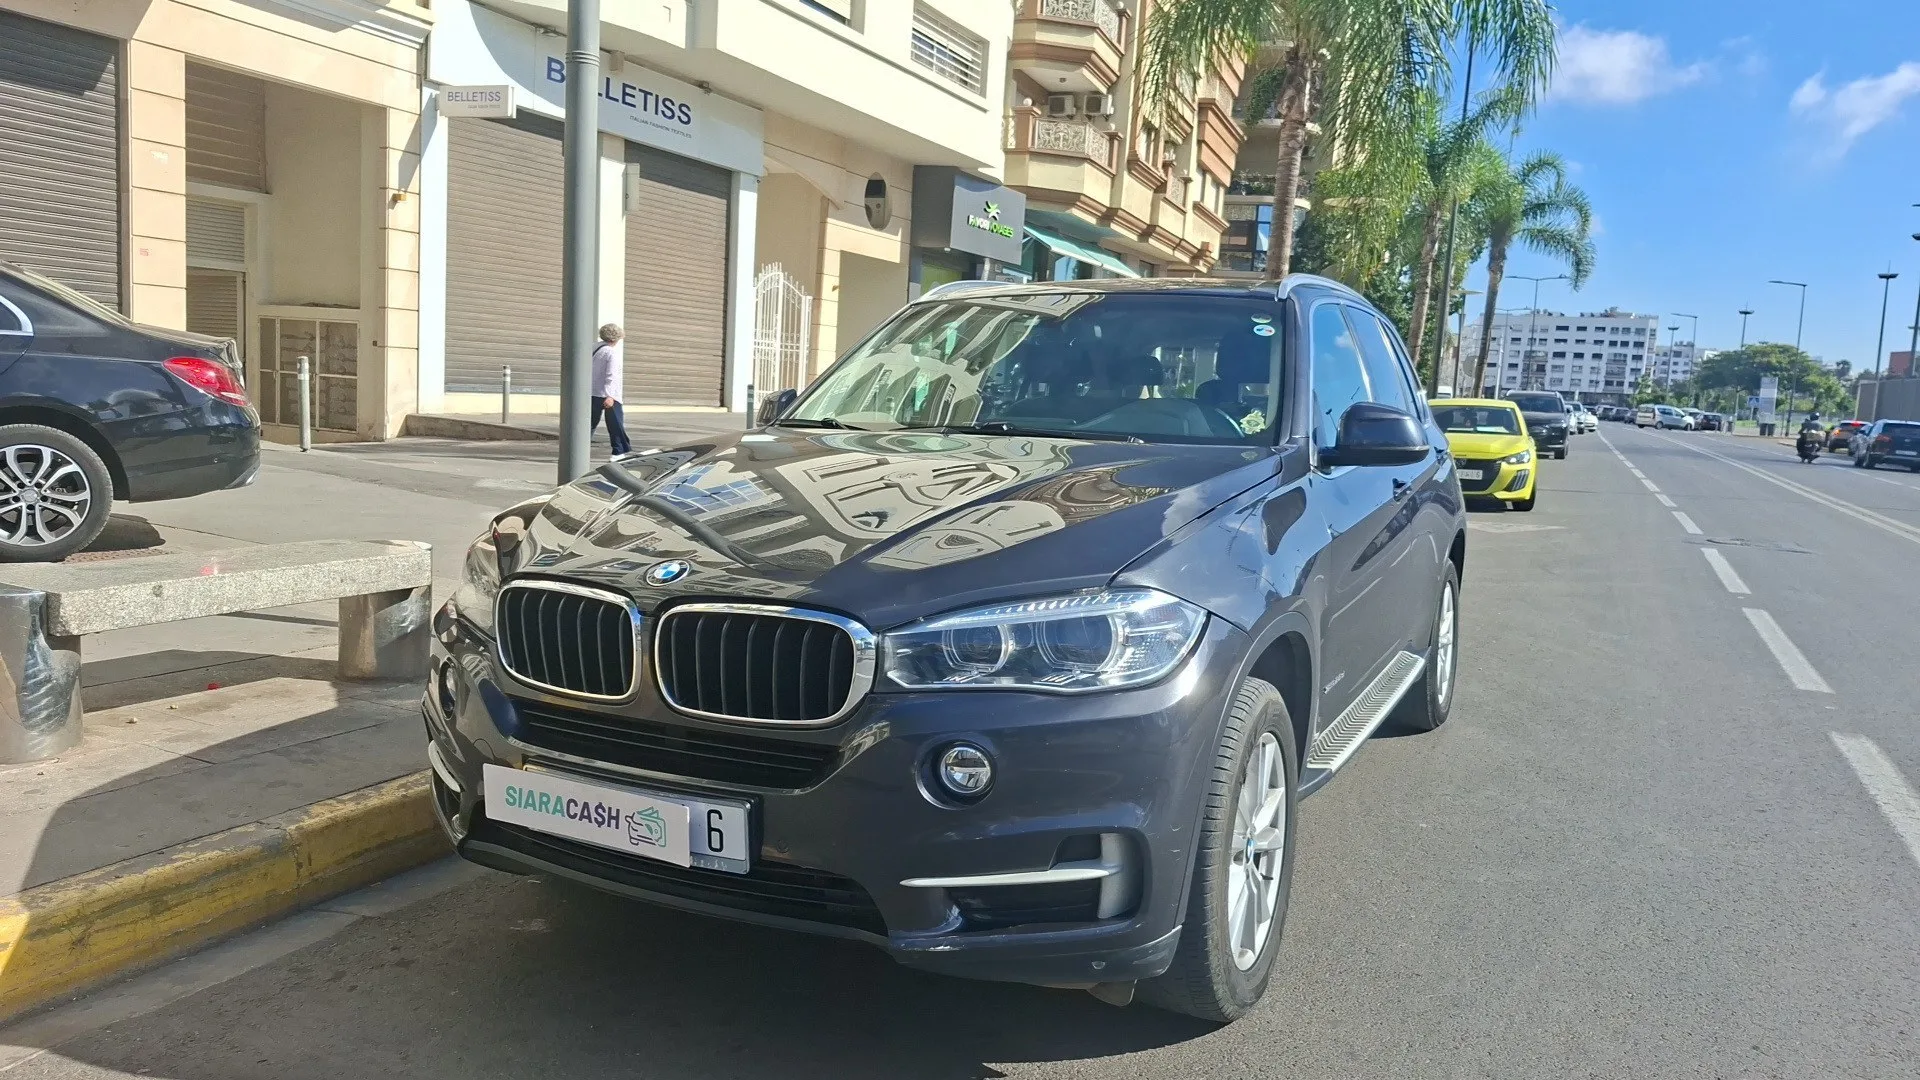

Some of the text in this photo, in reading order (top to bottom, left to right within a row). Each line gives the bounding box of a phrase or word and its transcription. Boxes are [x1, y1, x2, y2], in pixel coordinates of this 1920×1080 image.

[447, 91, 502, 102] BELLETISS
[547, 56, 692, 126] BLETISS
[629, 115, 649, 126] ITALIAN
[649, 121, 670, 132] FASHION
[706, 808, 724, 853] 6
